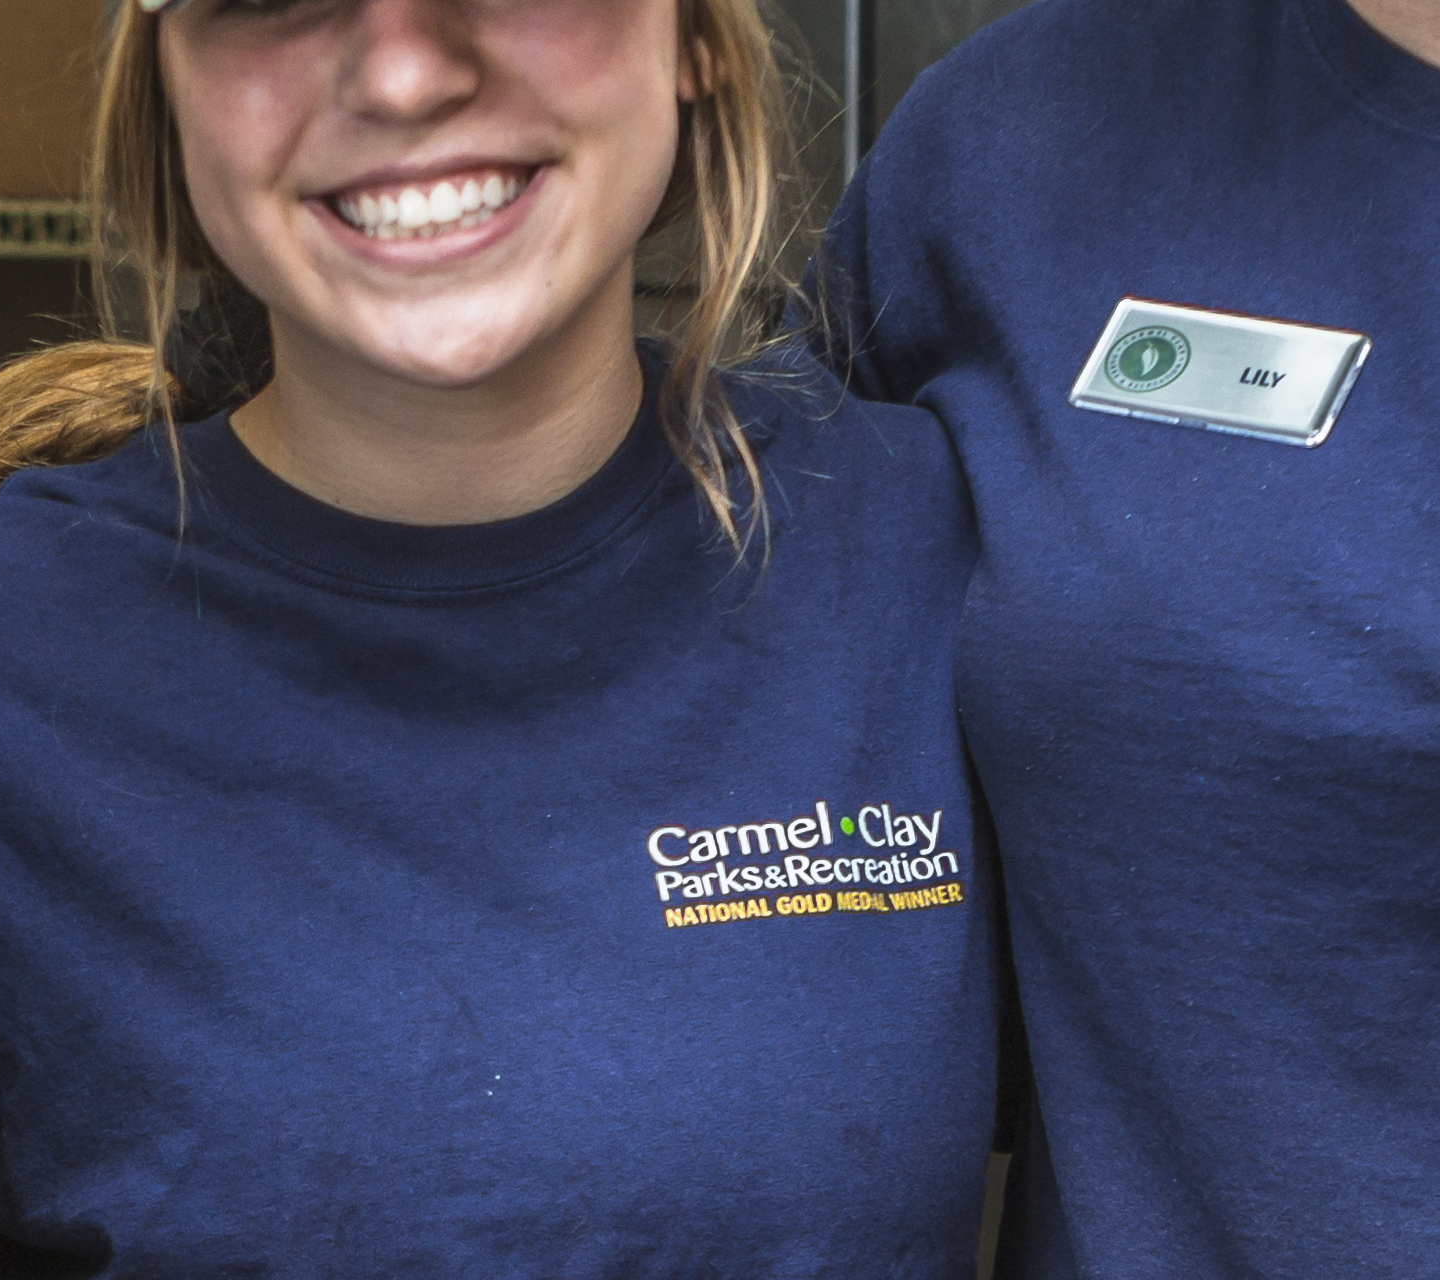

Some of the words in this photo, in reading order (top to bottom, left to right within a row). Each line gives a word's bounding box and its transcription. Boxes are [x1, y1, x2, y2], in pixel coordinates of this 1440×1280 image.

[1238, 366, 1287, 389] LILY
[646, 800, 834, 868] Carmel
[857, 803, 943, 856] Clay
[654, 850, 959, 902] Parks&Recreation
[664, 897, 773, 928] NATIONAL
[775, 892, 833, 916] GOLD
[836, 890, 890, 912] MEDAL
[889, 882, 964, 912] WINNER
